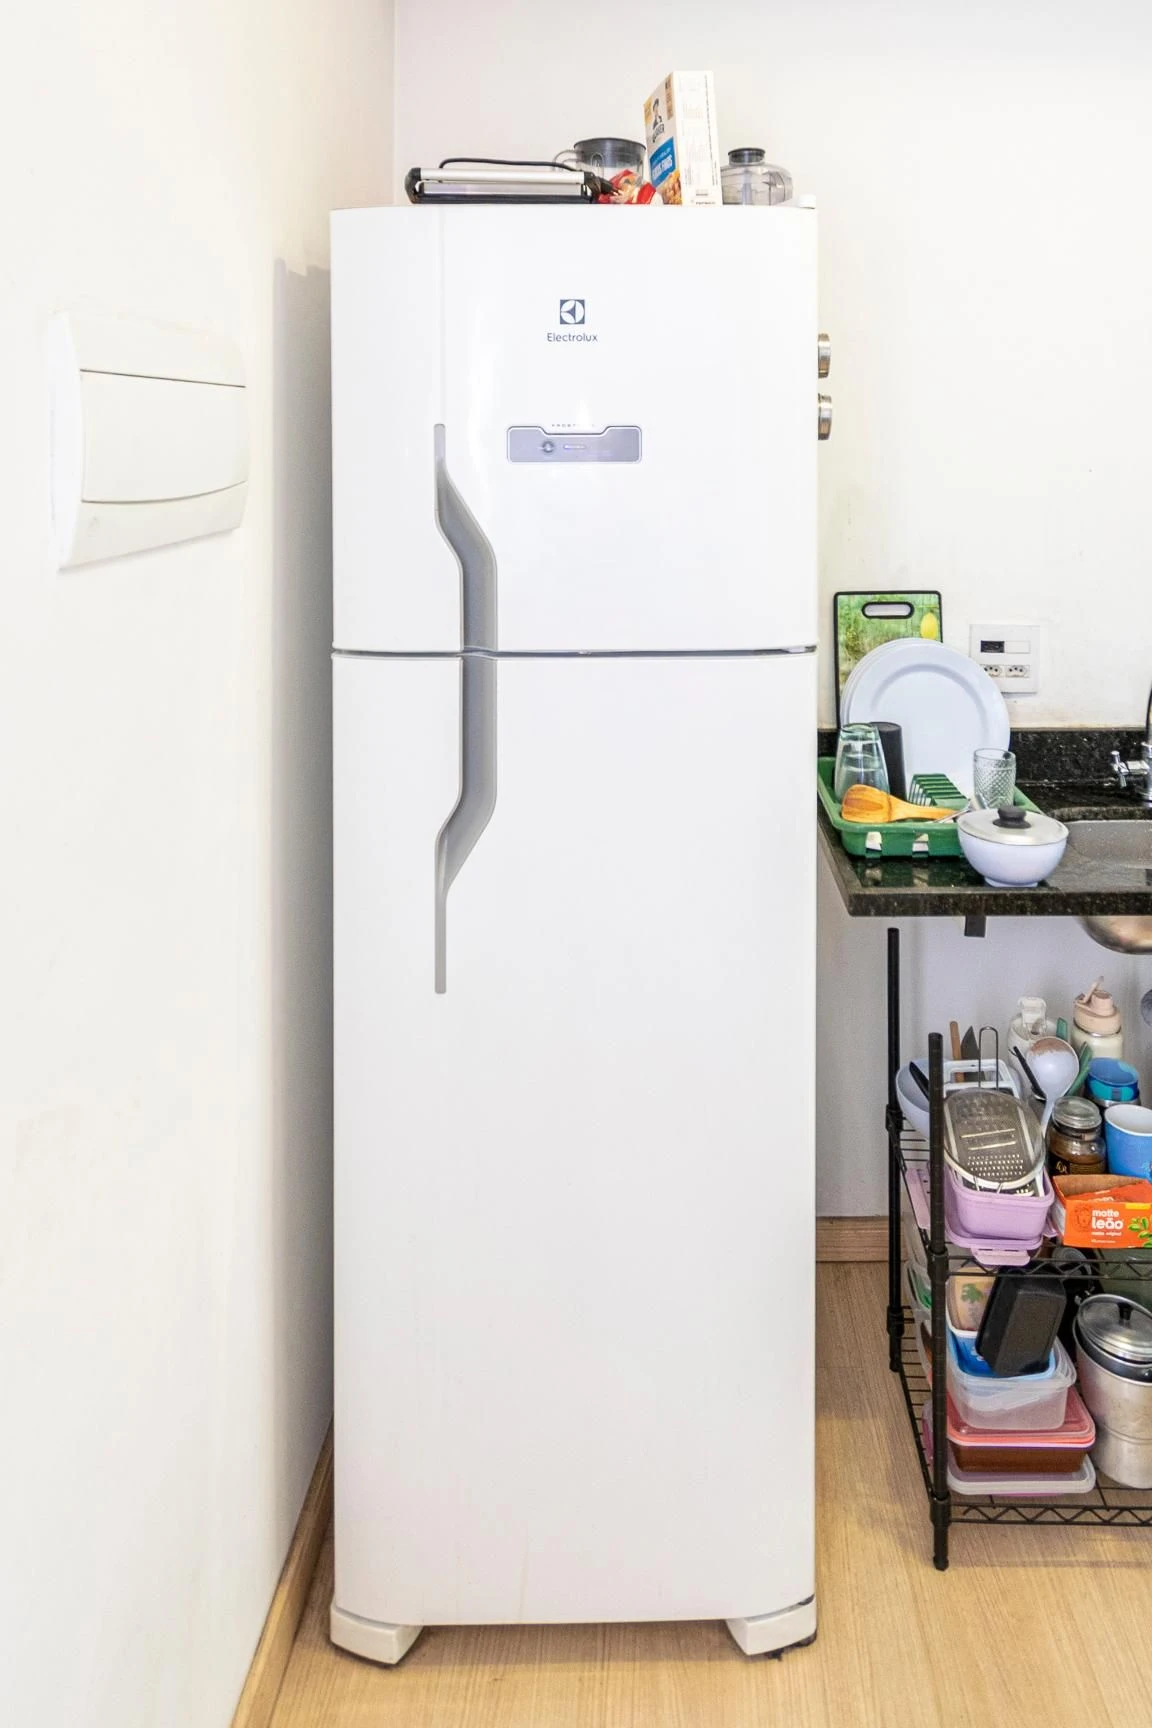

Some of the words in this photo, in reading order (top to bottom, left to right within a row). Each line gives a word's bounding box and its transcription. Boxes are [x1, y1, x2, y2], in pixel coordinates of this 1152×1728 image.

[547, 332, 598, 342] Electrolux
[1092, 1209, 1119, 1217] matte
[1092, 1216, 1124, 1230] leão
